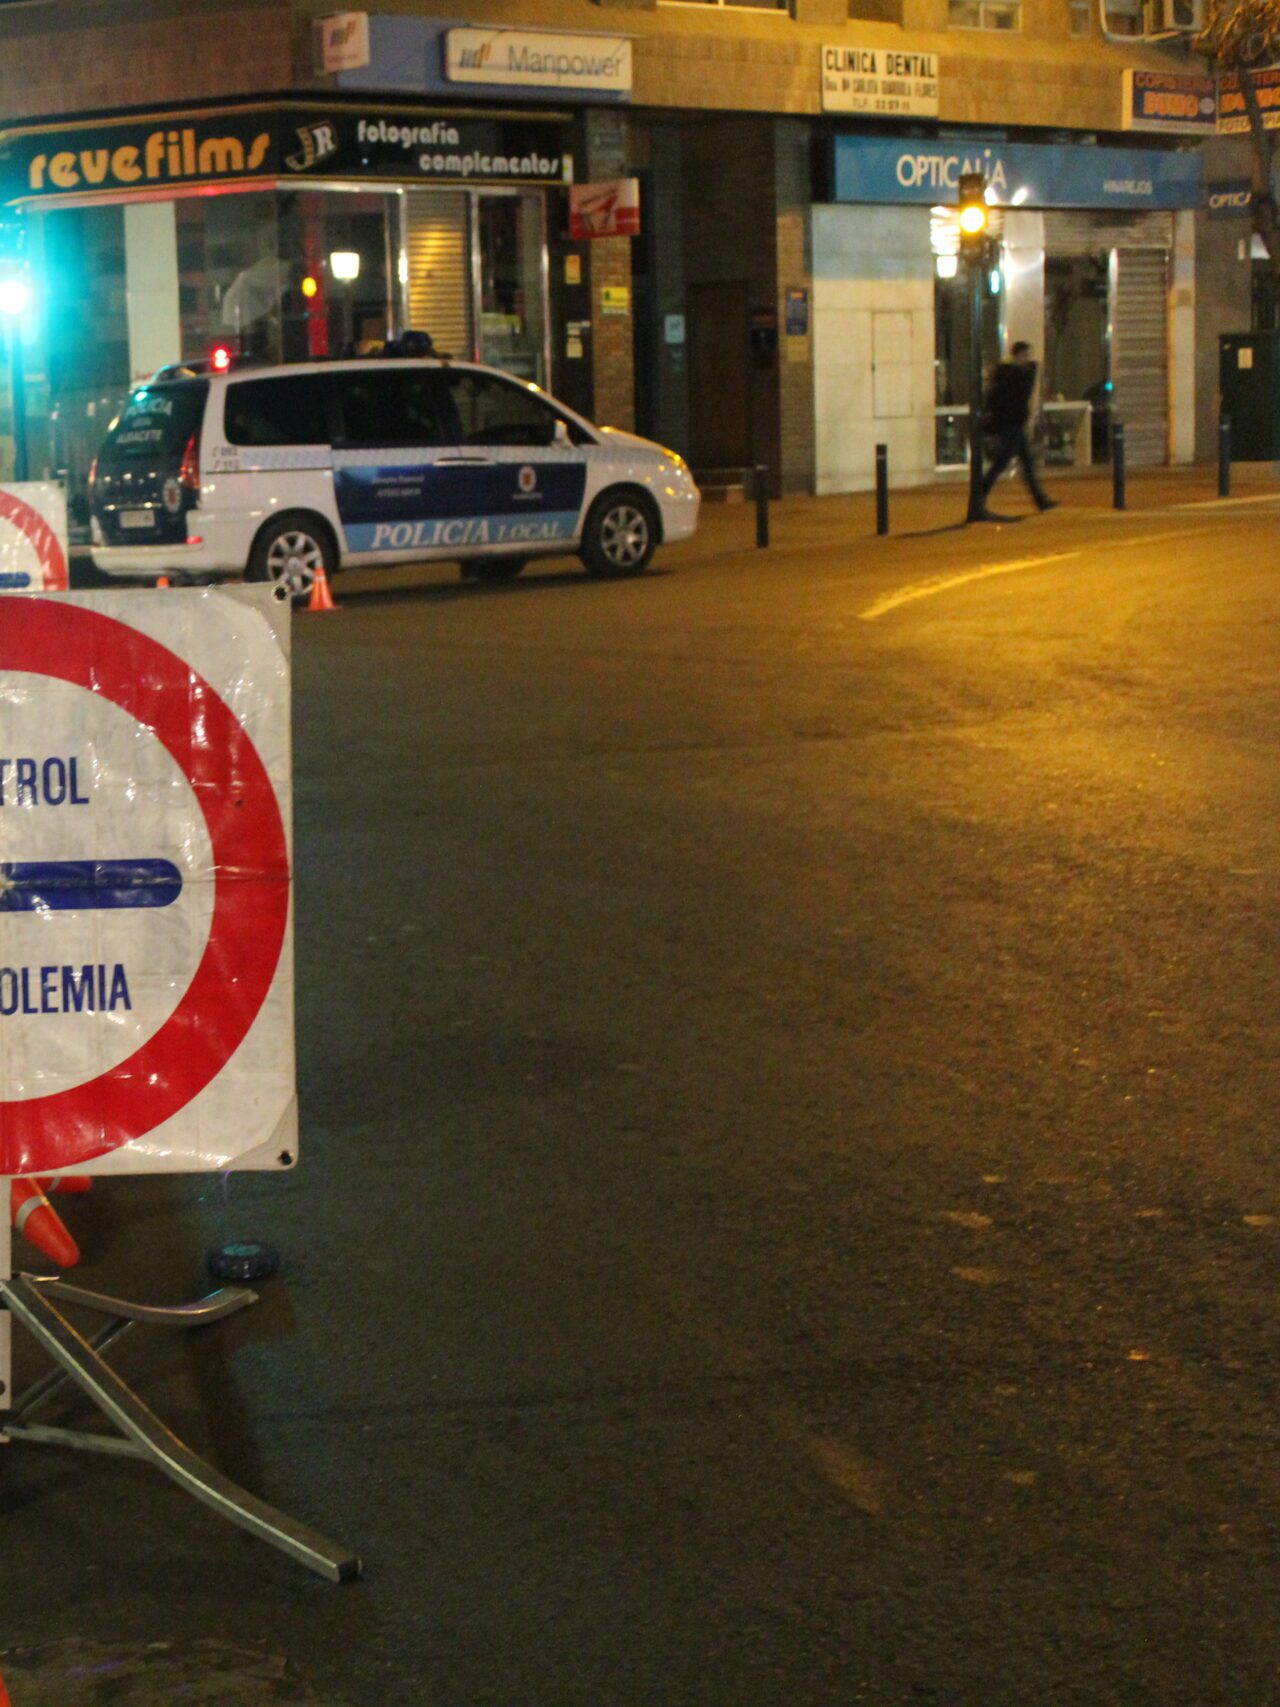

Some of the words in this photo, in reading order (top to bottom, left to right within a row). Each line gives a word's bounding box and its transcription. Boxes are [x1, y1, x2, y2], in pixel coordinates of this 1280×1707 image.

[508, 46, 623, 77] Manpower
[825, 50, 877, 73] CLINICA
[885, 54, 936, 78] DENTAL
[357, 119, 460, 148] fotografia
[29, 129, 270, 190] revefilms
[419, 151, 559, 176] complementos
[372, 519, 491, 549] POLICIA
[497, 521, 563, 541] LOCAL
